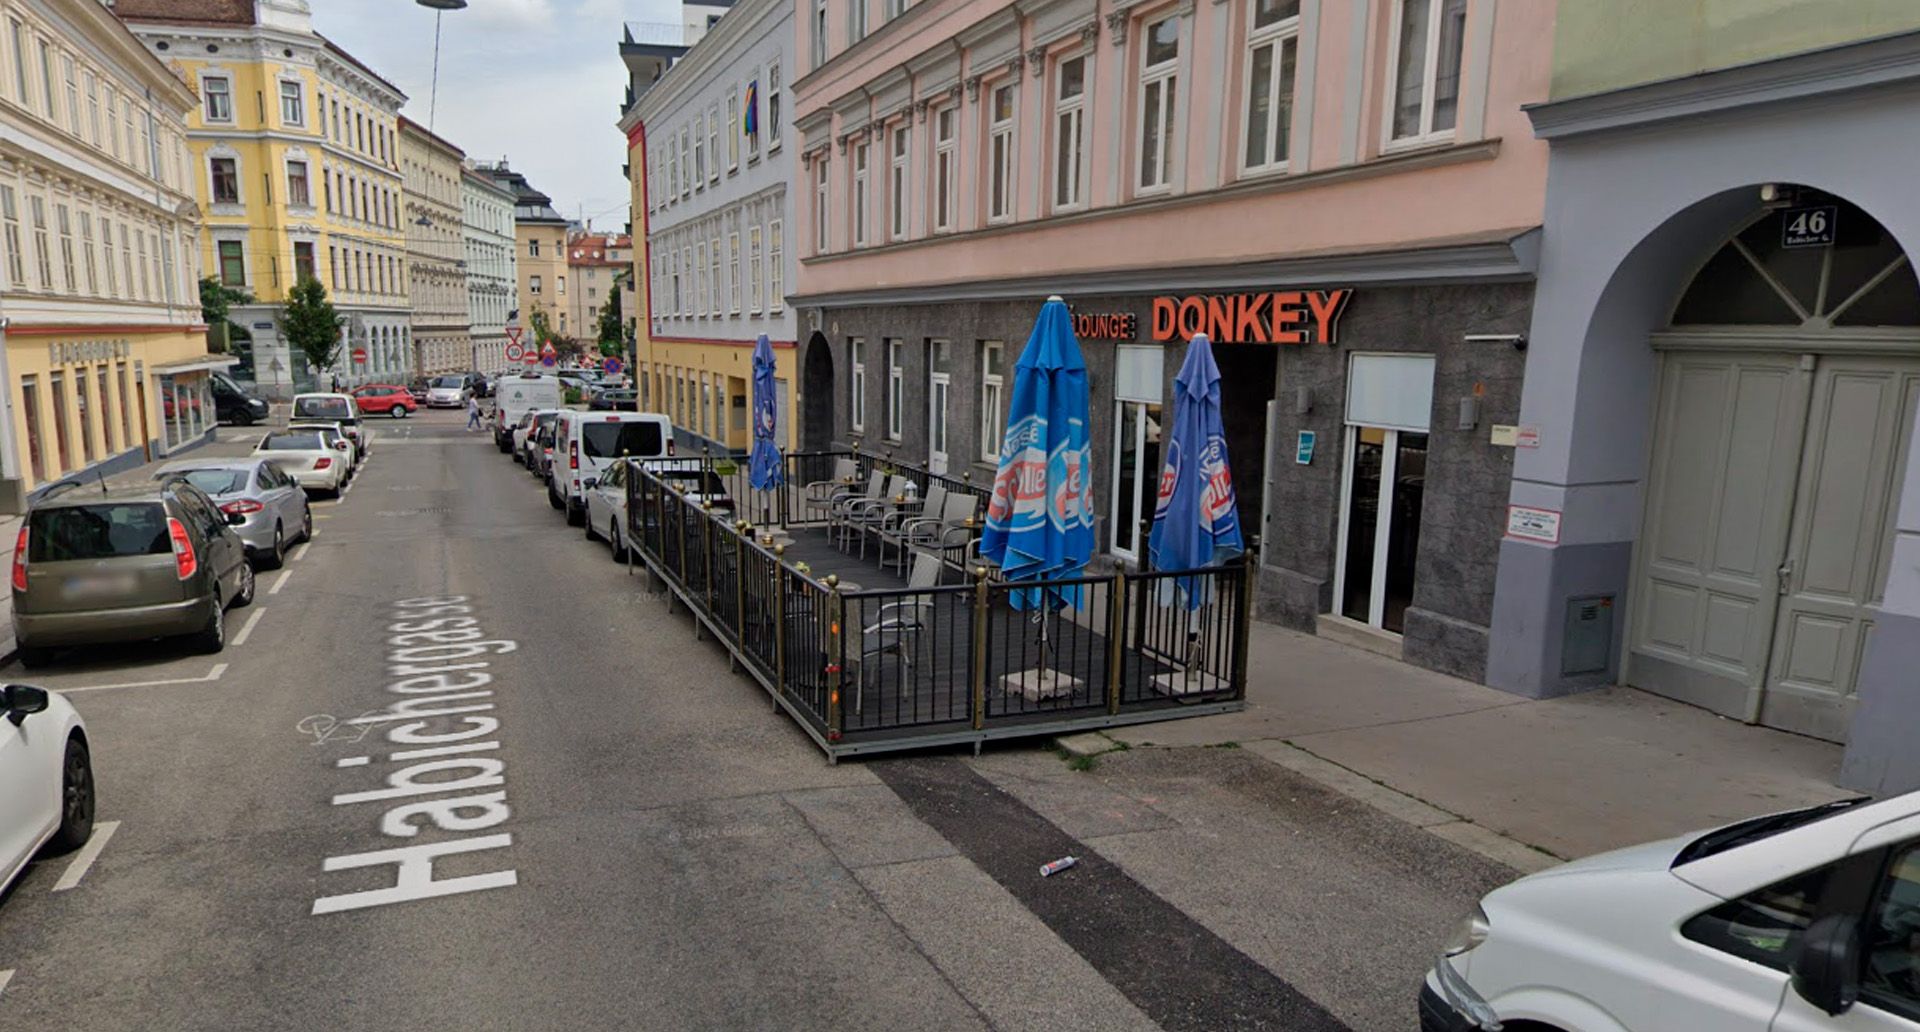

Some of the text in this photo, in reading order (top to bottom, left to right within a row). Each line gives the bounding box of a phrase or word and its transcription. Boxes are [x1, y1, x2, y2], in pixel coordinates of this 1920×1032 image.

[1788, 211, 1826, 235] 46
[1070, 290, 1346, 343] LOUNGE DONKEY
